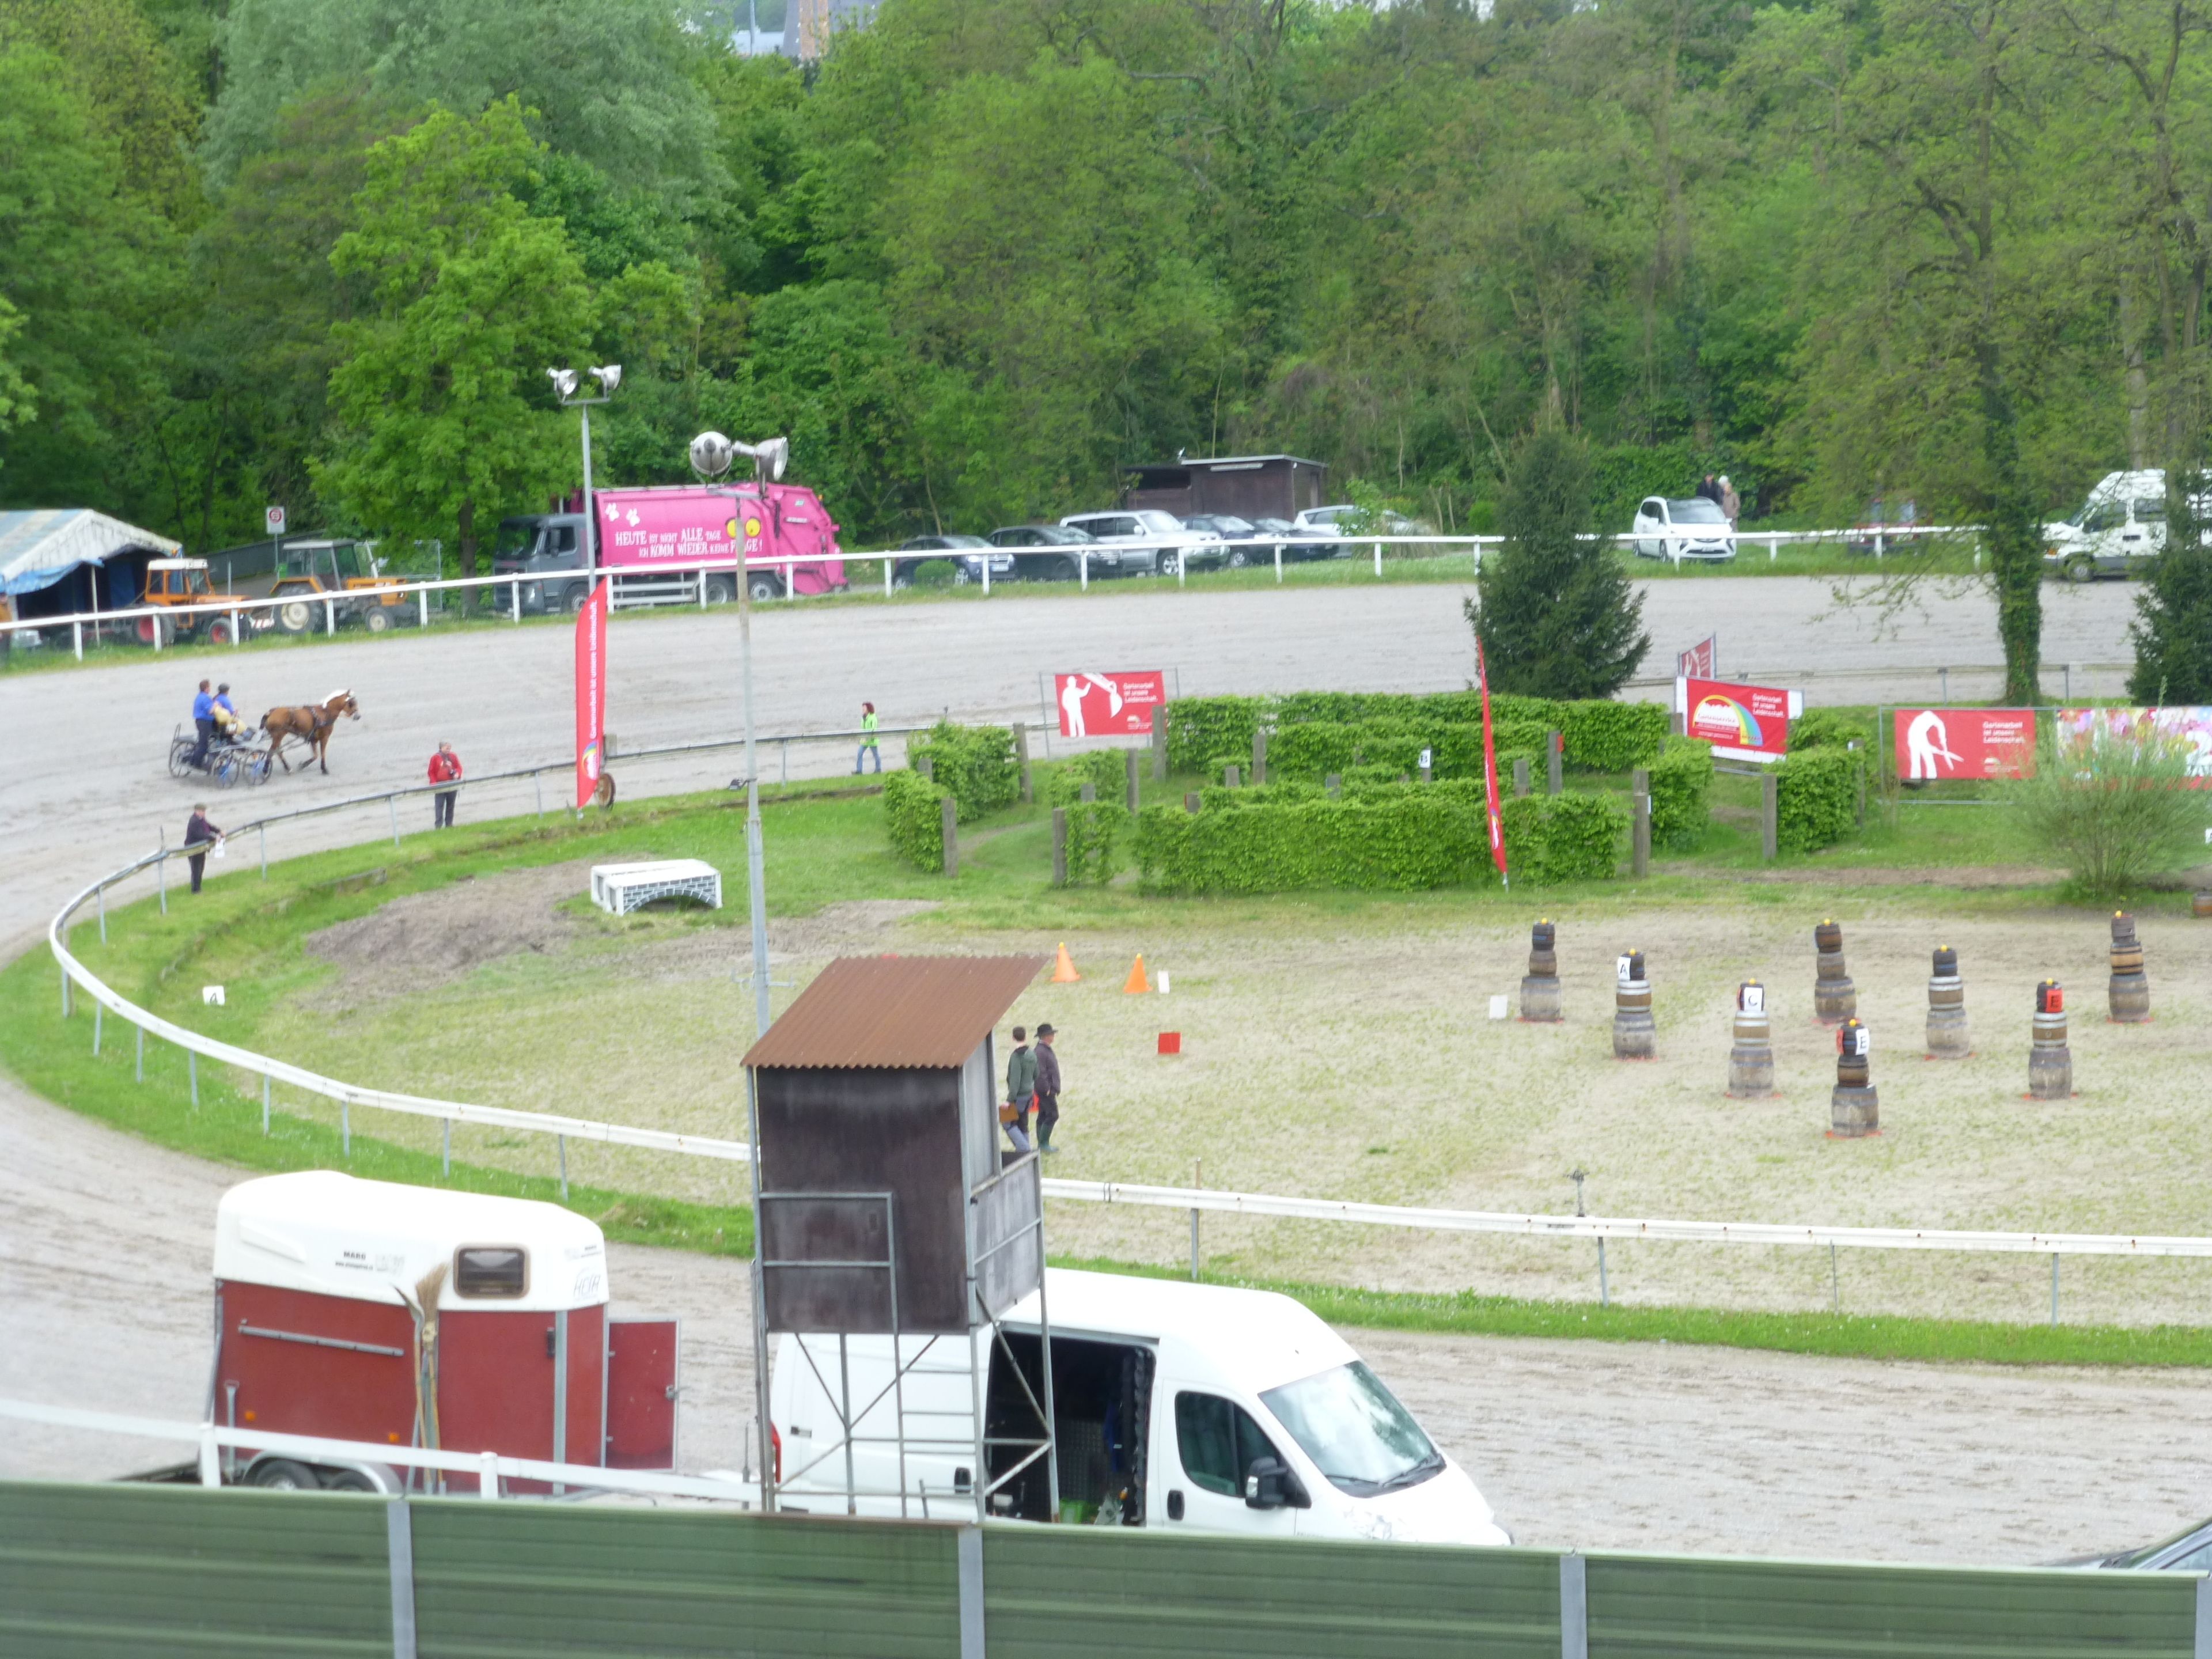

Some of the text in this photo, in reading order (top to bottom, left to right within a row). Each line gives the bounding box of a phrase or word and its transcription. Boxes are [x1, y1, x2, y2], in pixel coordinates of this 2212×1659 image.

[615, 527, 721, 546] HEUTE IST NICHT ALLE TAGE
[639, 547, 649, 558] ICH
[650, 543, 674, 558] KOMM
[709, 543, 729, 554] KEINE
[1983, 721, 2023, 729] Gartenarbeit
[1620, 963, 1627, 975] A
[1748, 994, 1758, 1007] C
[1860, 1036, 1867, 1049] E
